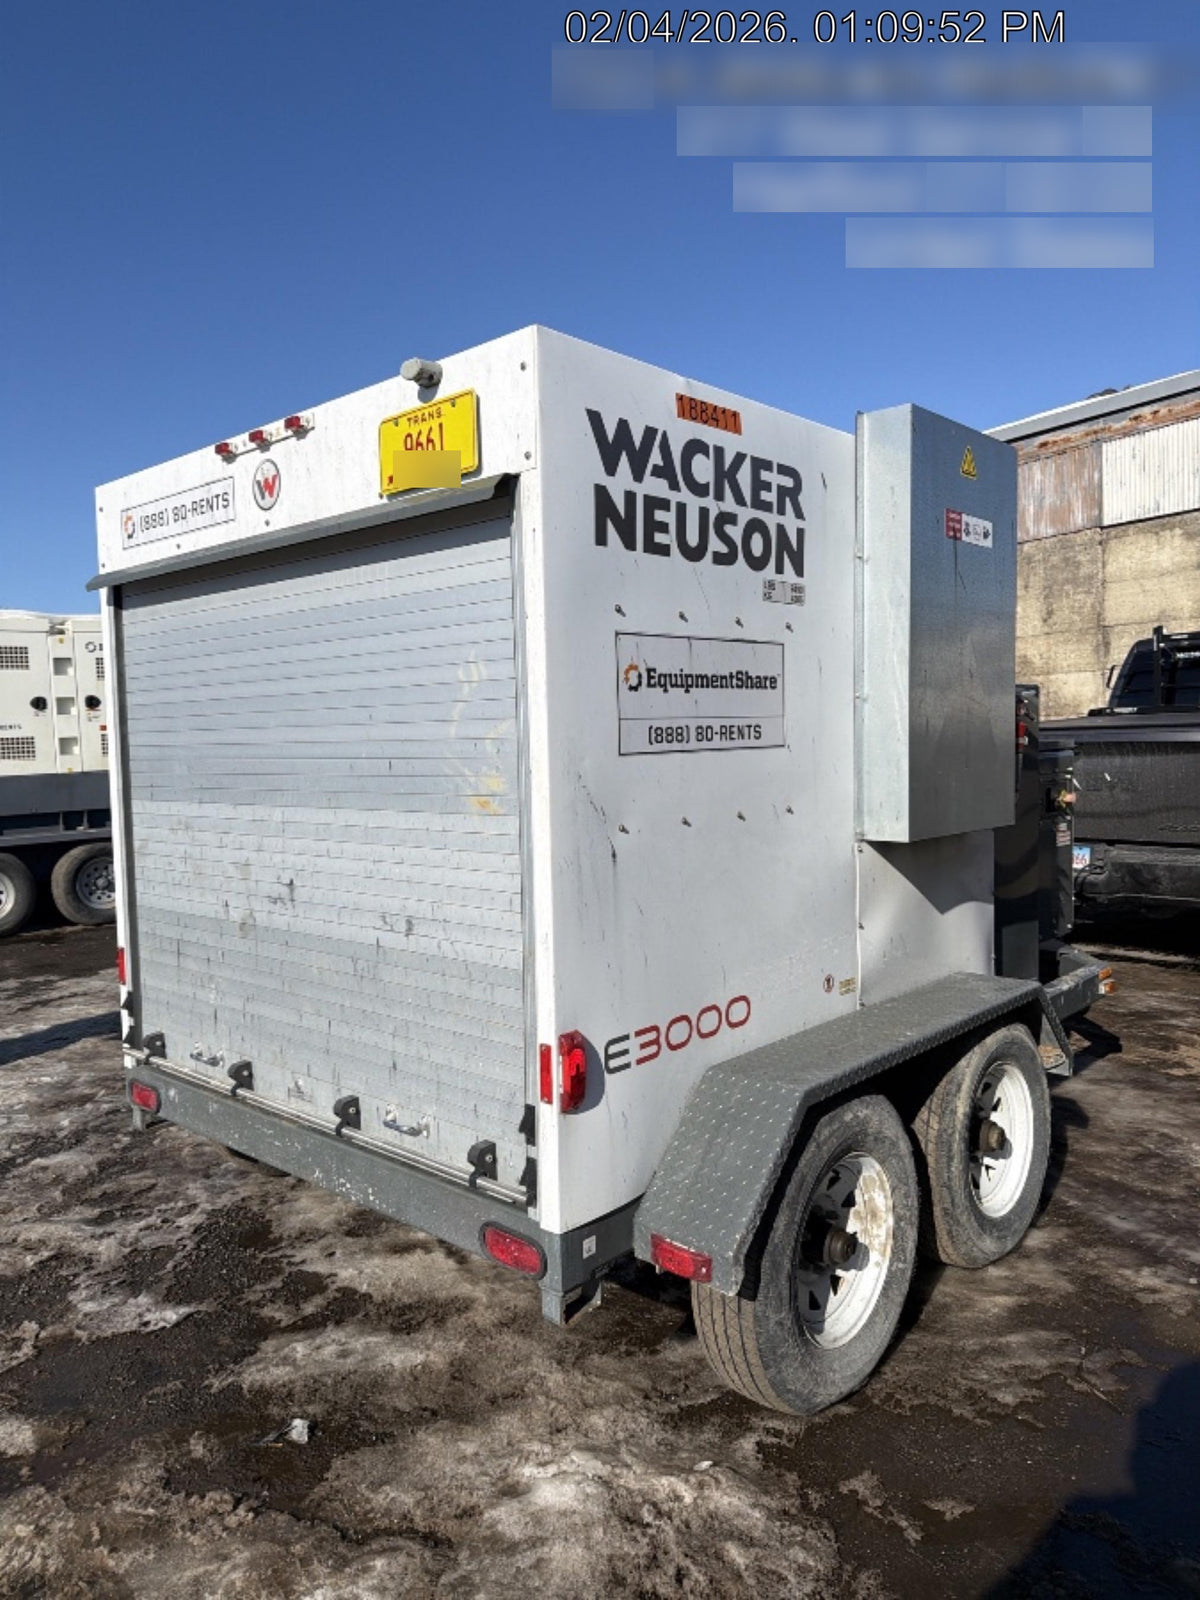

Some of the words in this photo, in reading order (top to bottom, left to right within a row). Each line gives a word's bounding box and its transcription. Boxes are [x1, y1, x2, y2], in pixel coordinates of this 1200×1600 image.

[406, 406, 444, 428] TRANS
[676, 394, 738, 434] 188411
[585, 407, 805, 521] WACKER
[139, 508, 170, 533] (888)
[172, 491, 230, 523] 80-RENTS
[594, 483, 804, 578] NEUSON
[646, 667, 778, 693] EquipmentShare
[648, 725, 691, 746] (888)
[695, 724, 762, 743] 80-RENTS
[604, 994, 751, 1075] E3000
